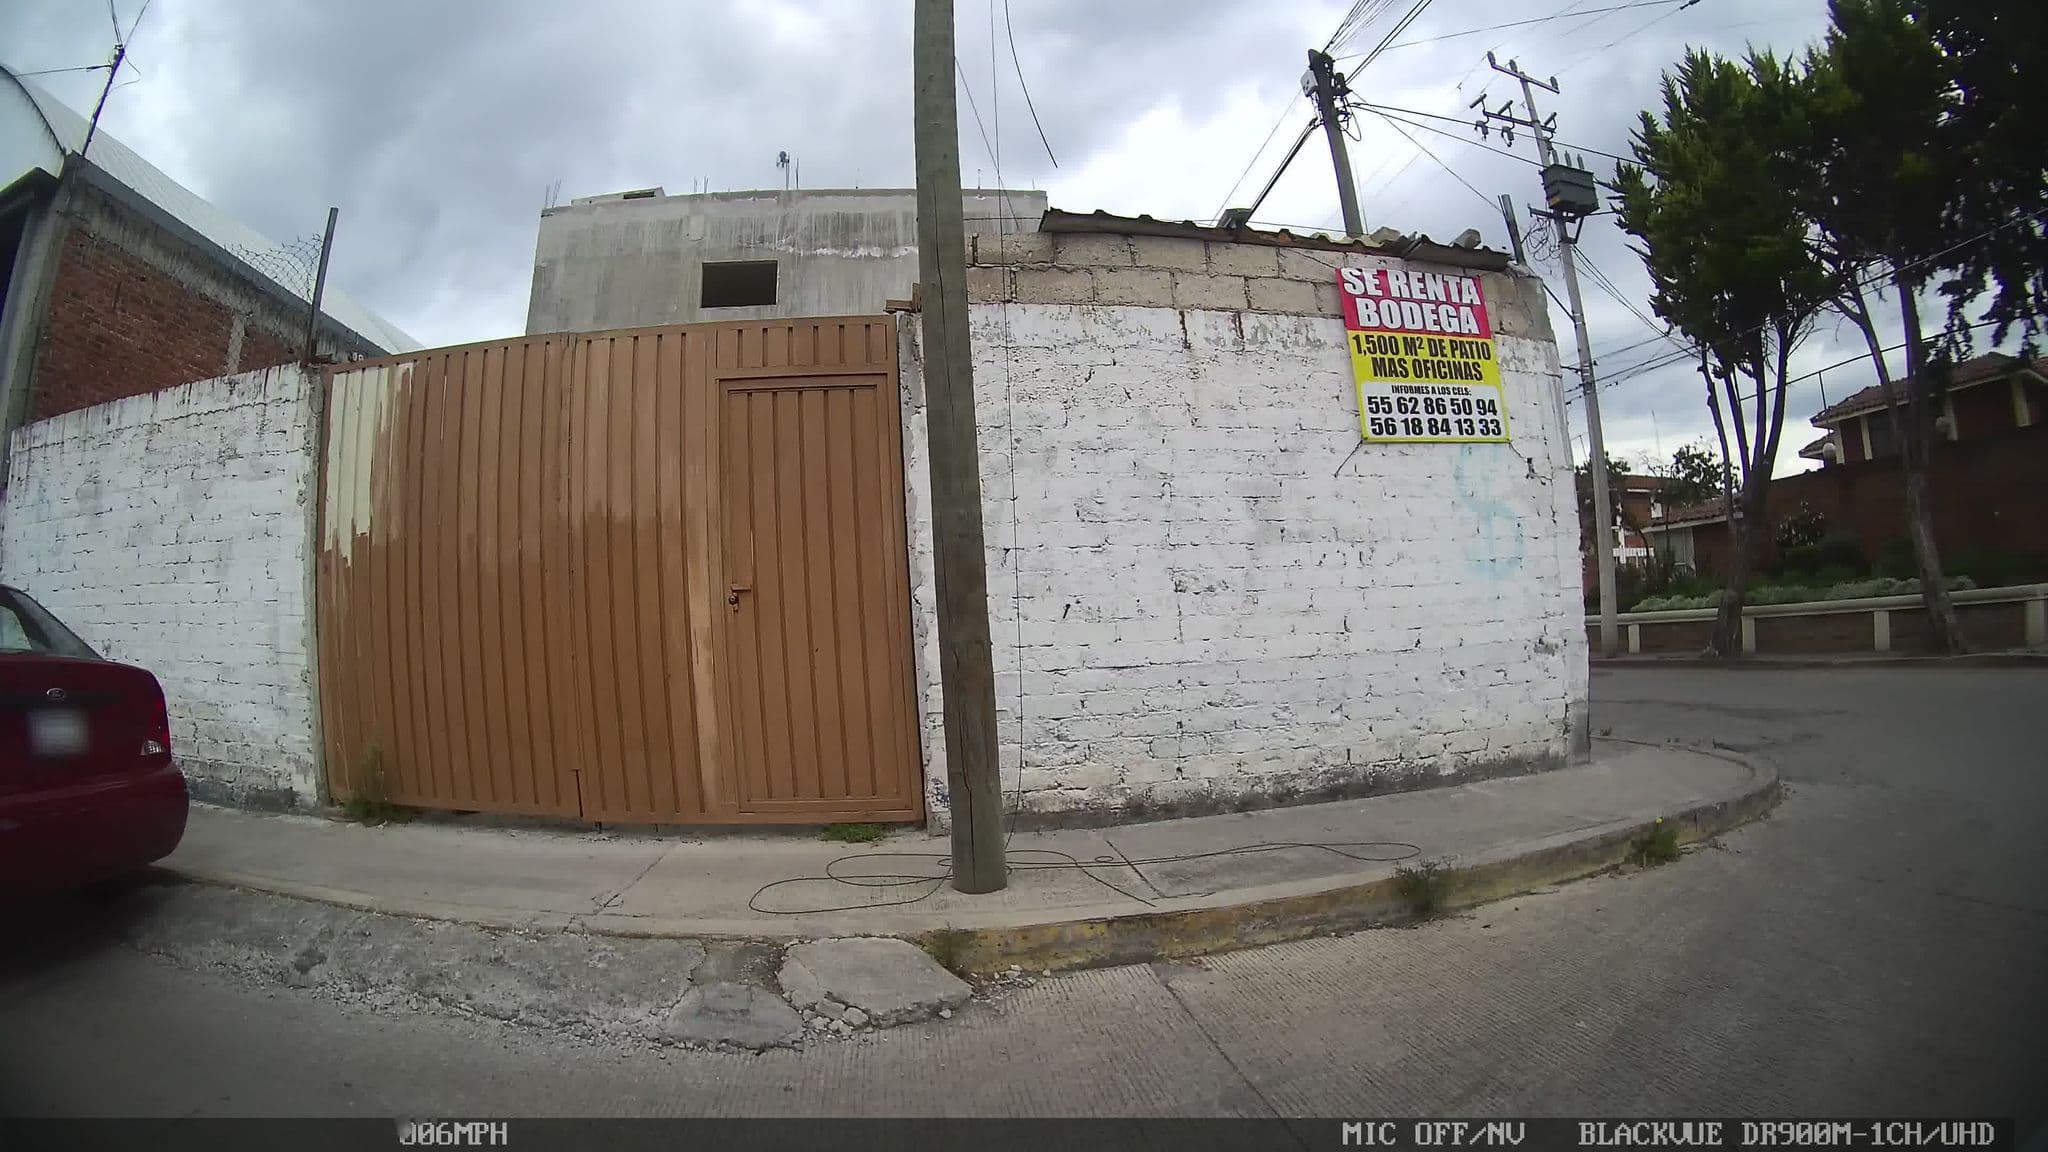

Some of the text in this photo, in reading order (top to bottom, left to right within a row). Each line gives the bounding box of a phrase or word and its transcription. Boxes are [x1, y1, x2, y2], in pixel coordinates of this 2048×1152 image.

[1341, 267, 1481, 305] SE RENTA
[1355, 297, 1480, 335] BODEGA
[1352, 335, 1399, 356] 1,500
[1427, 338, 1448, 358] DE
[1449, 340, 1491, 361] PATIO
[1372, 358, 1483, 381] MAS OFICINAS
[1392, 384, 1430, 396] INFORMES
[1431, 386, 1437, 395] A
[1438, 386, 1451, 396] LOS
[1367, 396, 1498, 416] 55 62 86 50 94
[1370, 417, 1502, 436] 56 18 84 13 33
